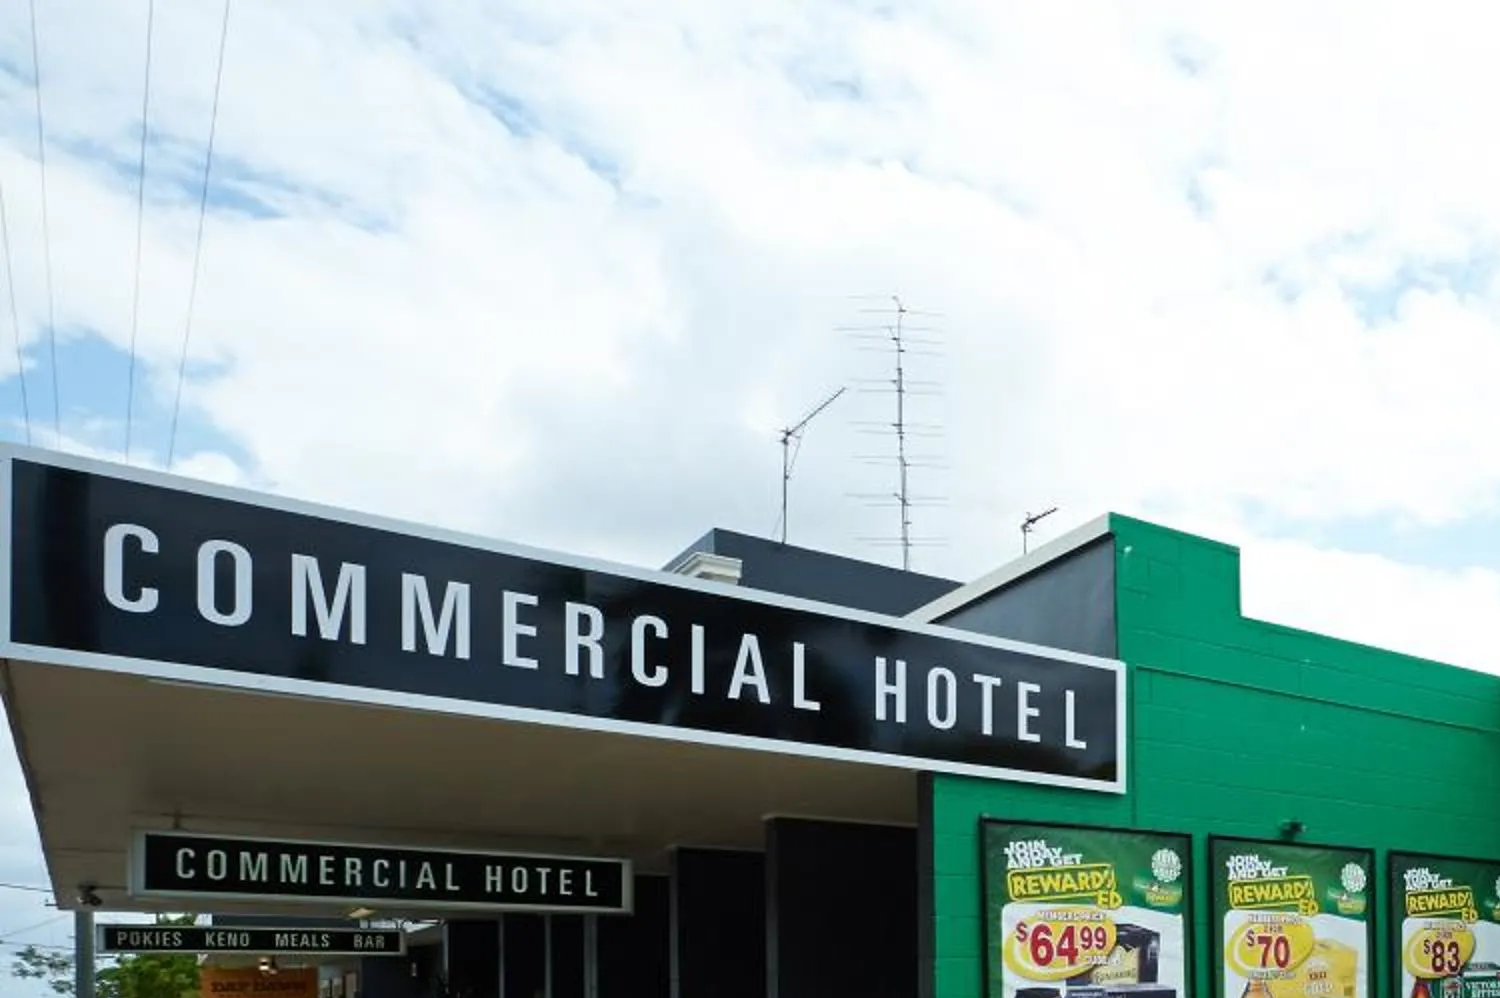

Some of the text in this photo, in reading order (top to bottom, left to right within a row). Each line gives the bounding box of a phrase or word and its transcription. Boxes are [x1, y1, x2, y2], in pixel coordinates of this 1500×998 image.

[104, 523, 1087, 750] COMMERCIAL HOTEL
[176, 847, 599, 897] COMMERCIAL HOTEL
[117, 931, 385, 949] POKIES KENO MEALS BAR
[1246, 929, 1290, 969] $70
[1424, 940, 1460, 973] $83
